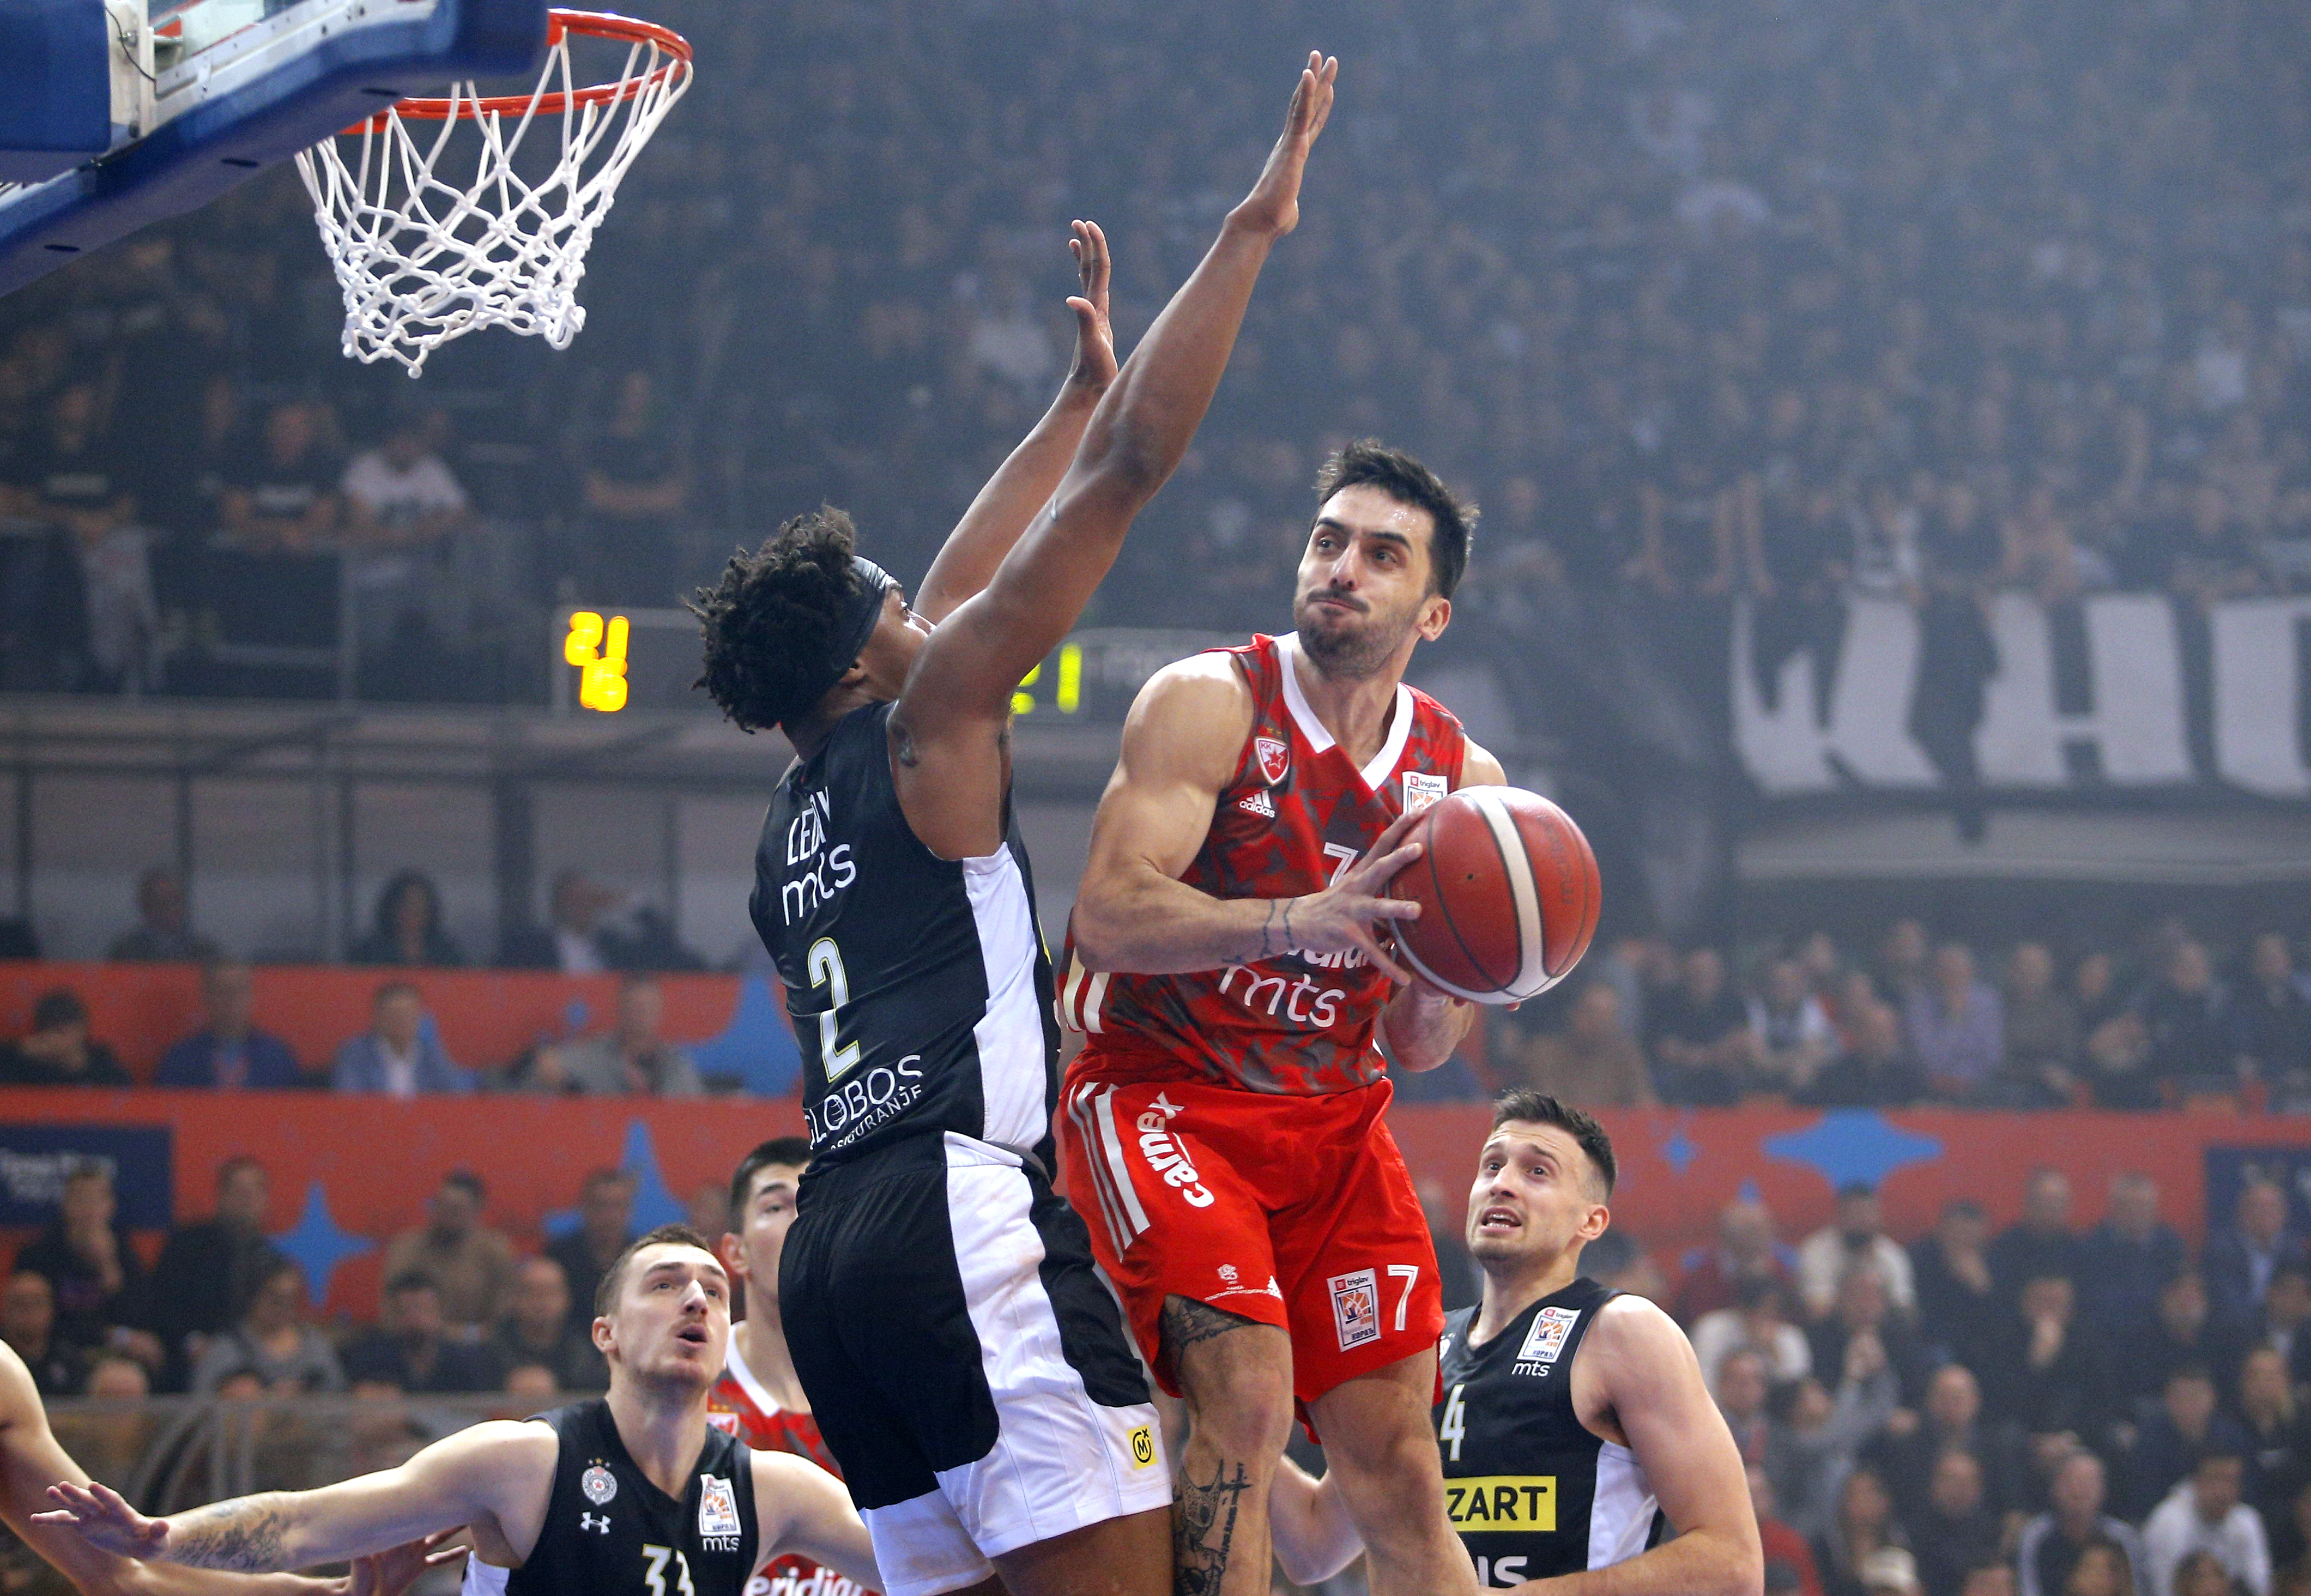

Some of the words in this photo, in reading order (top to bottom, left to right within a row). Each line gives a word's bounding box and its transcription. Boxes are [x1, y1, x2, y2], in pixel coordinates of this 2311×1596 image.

[1239, 800, 1276, 818] adidas
[1420, 779, 1441, 789] triglav
[782, 843, 856, 926] mts
[807, 936, 861, 1084] 2
[1218, 964, 1346, 1027] mts
[1136, 1090, 1215, 1208] carnex
[1347, 1276, 1369, 1286] triglav
[1387, 1264, 1419, 1331] 7
[1511, 1361, 1551, 1377] mts
[1439, 1383, 1466, 1462] 4
[1447, 1485, 1548, 1522] ZART
[703, 1534, 740, 1552] mts
